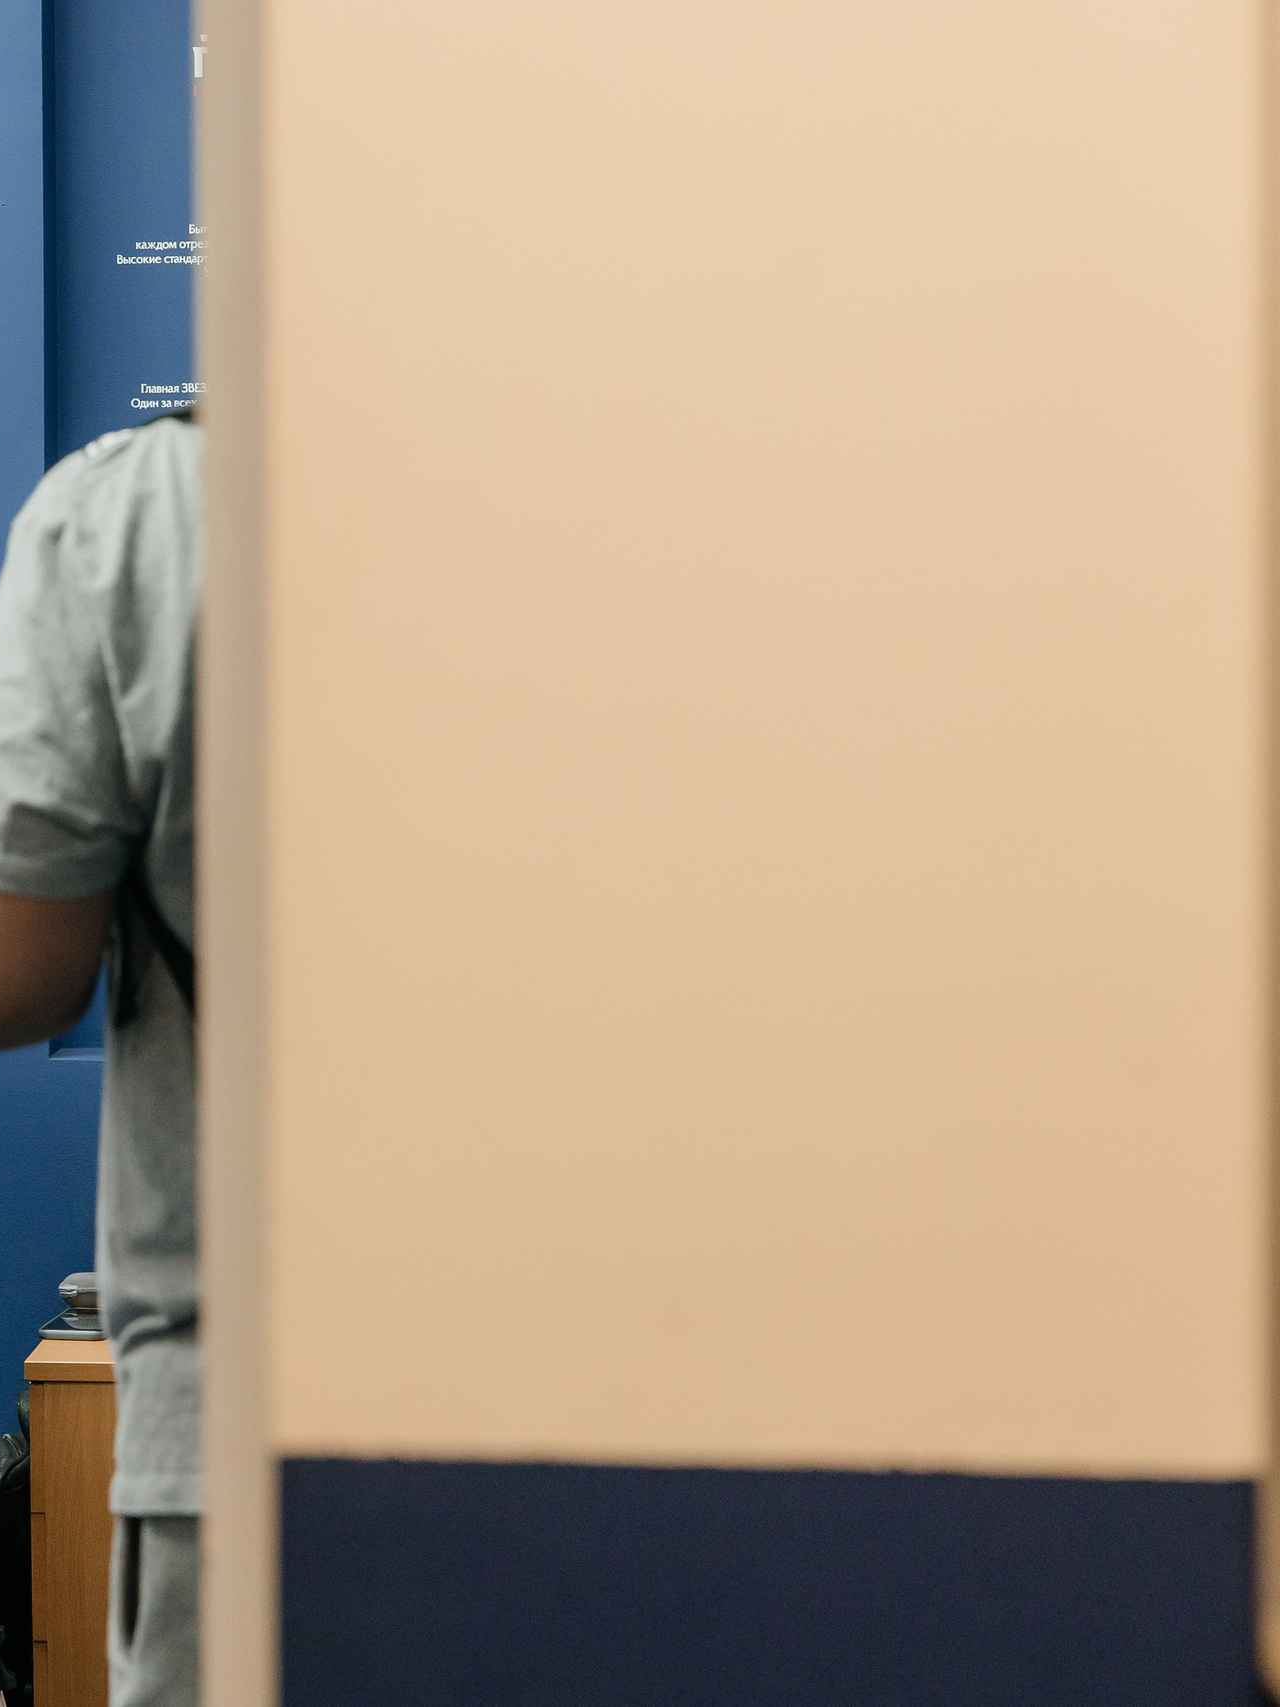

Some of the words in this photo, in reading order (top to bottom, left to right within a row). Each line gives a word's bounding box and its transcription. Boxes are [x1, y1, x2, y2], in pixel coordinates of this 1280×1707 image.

[188, 223, 207, 234] Быт
[135, 241, 177, 251] каждом
[179, 240, 208, 252] отрез
[116, 254, 162, 265] Высокие
[163, 254, 208, 266] стандарт
[140, 383, 180, 394] Главная
[181, 382, 208, 393] ЗВЕЗ
[130, 397, 159, 410] Один
[160, 399, 173, 408] за
